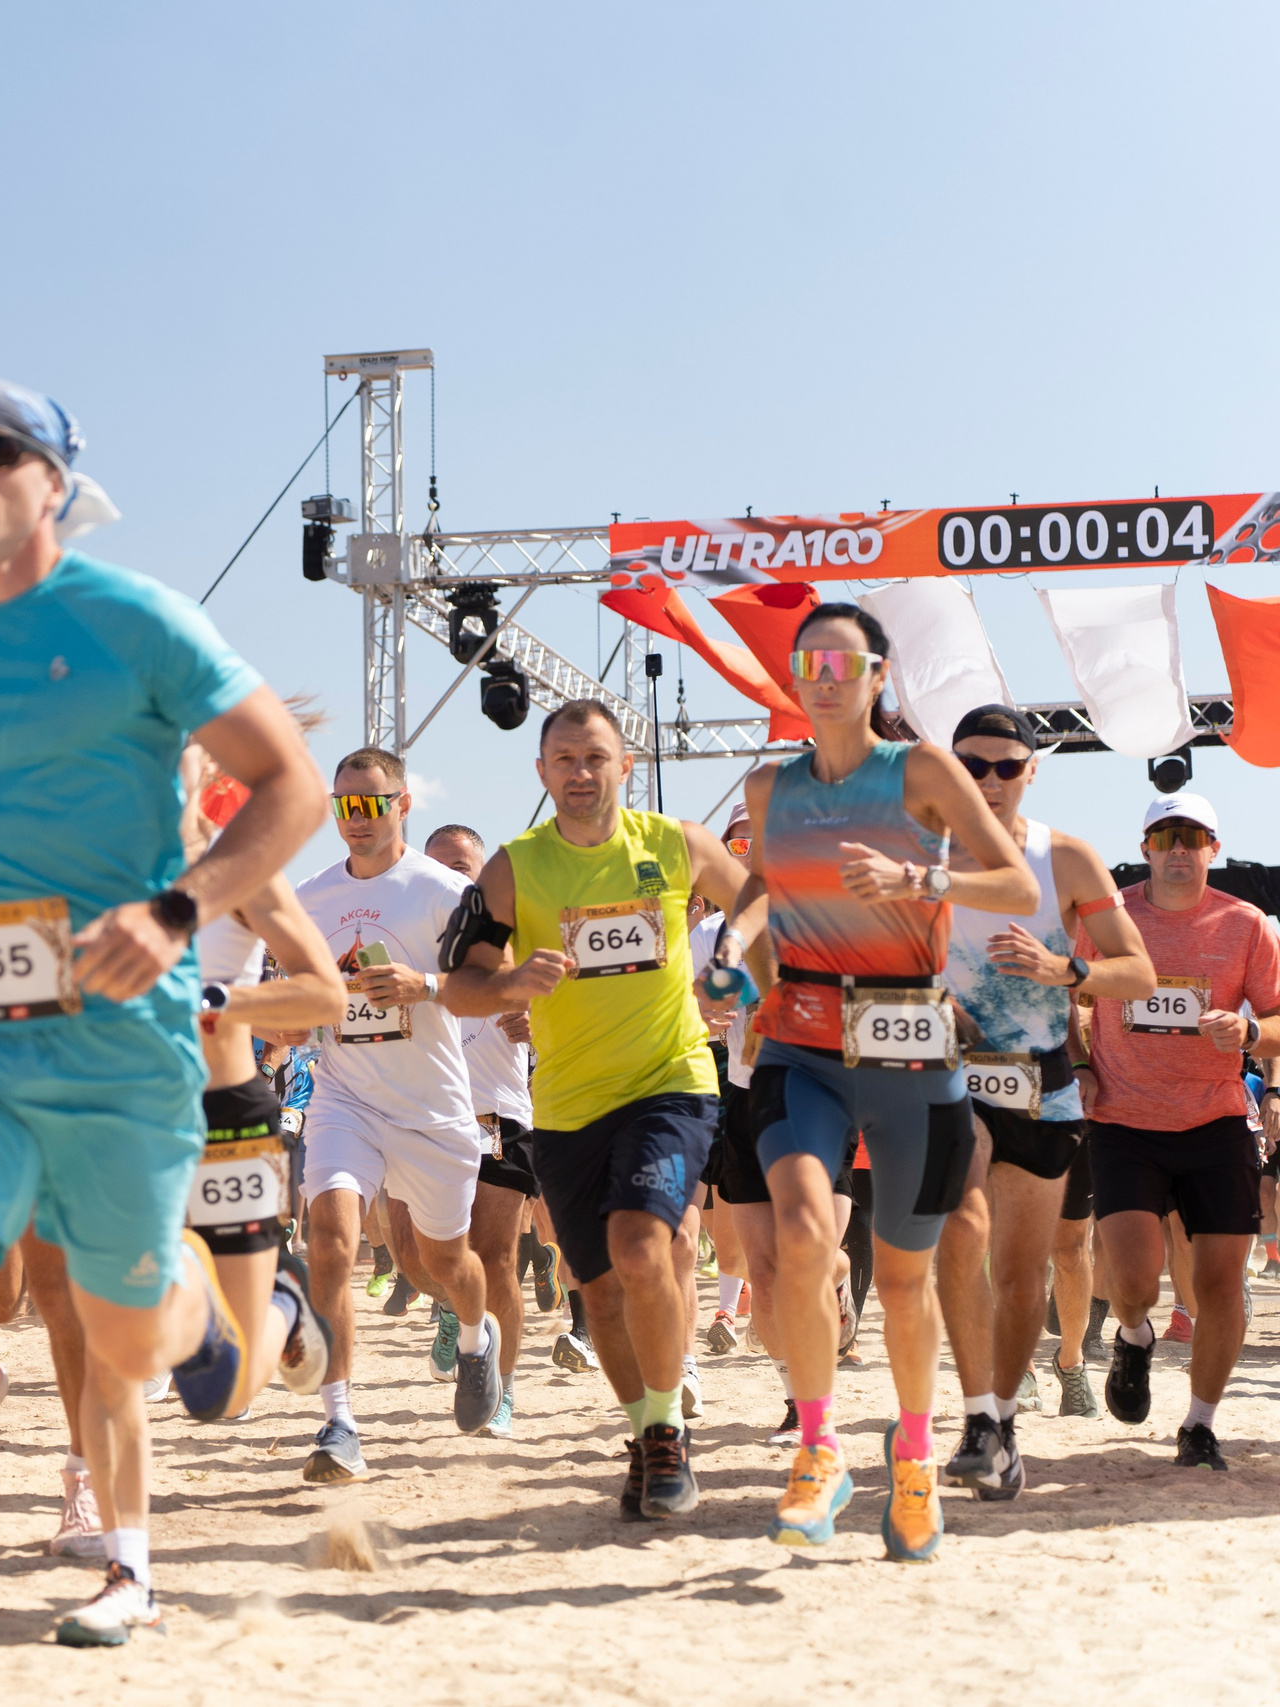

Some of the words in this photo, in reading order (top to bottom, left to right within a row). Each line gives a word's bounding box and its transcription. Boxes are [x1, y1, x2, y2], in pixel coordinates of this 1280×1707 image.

[942, 505, 1209, 566] 00:00:04
[660, 527, 883, 572] ULTRA100
[340, 908, 381, 925] АКСАЙ
[587, 906, 618, 916] ПЕСОК
[588, 926, 643, 951] 664
[1147, 996, 1186, 1015] 616
[872, 1018, 931, 1041] 838
[967, 1074, 1018, 1095] 809
[202, 1174, 263, 1204] 633
